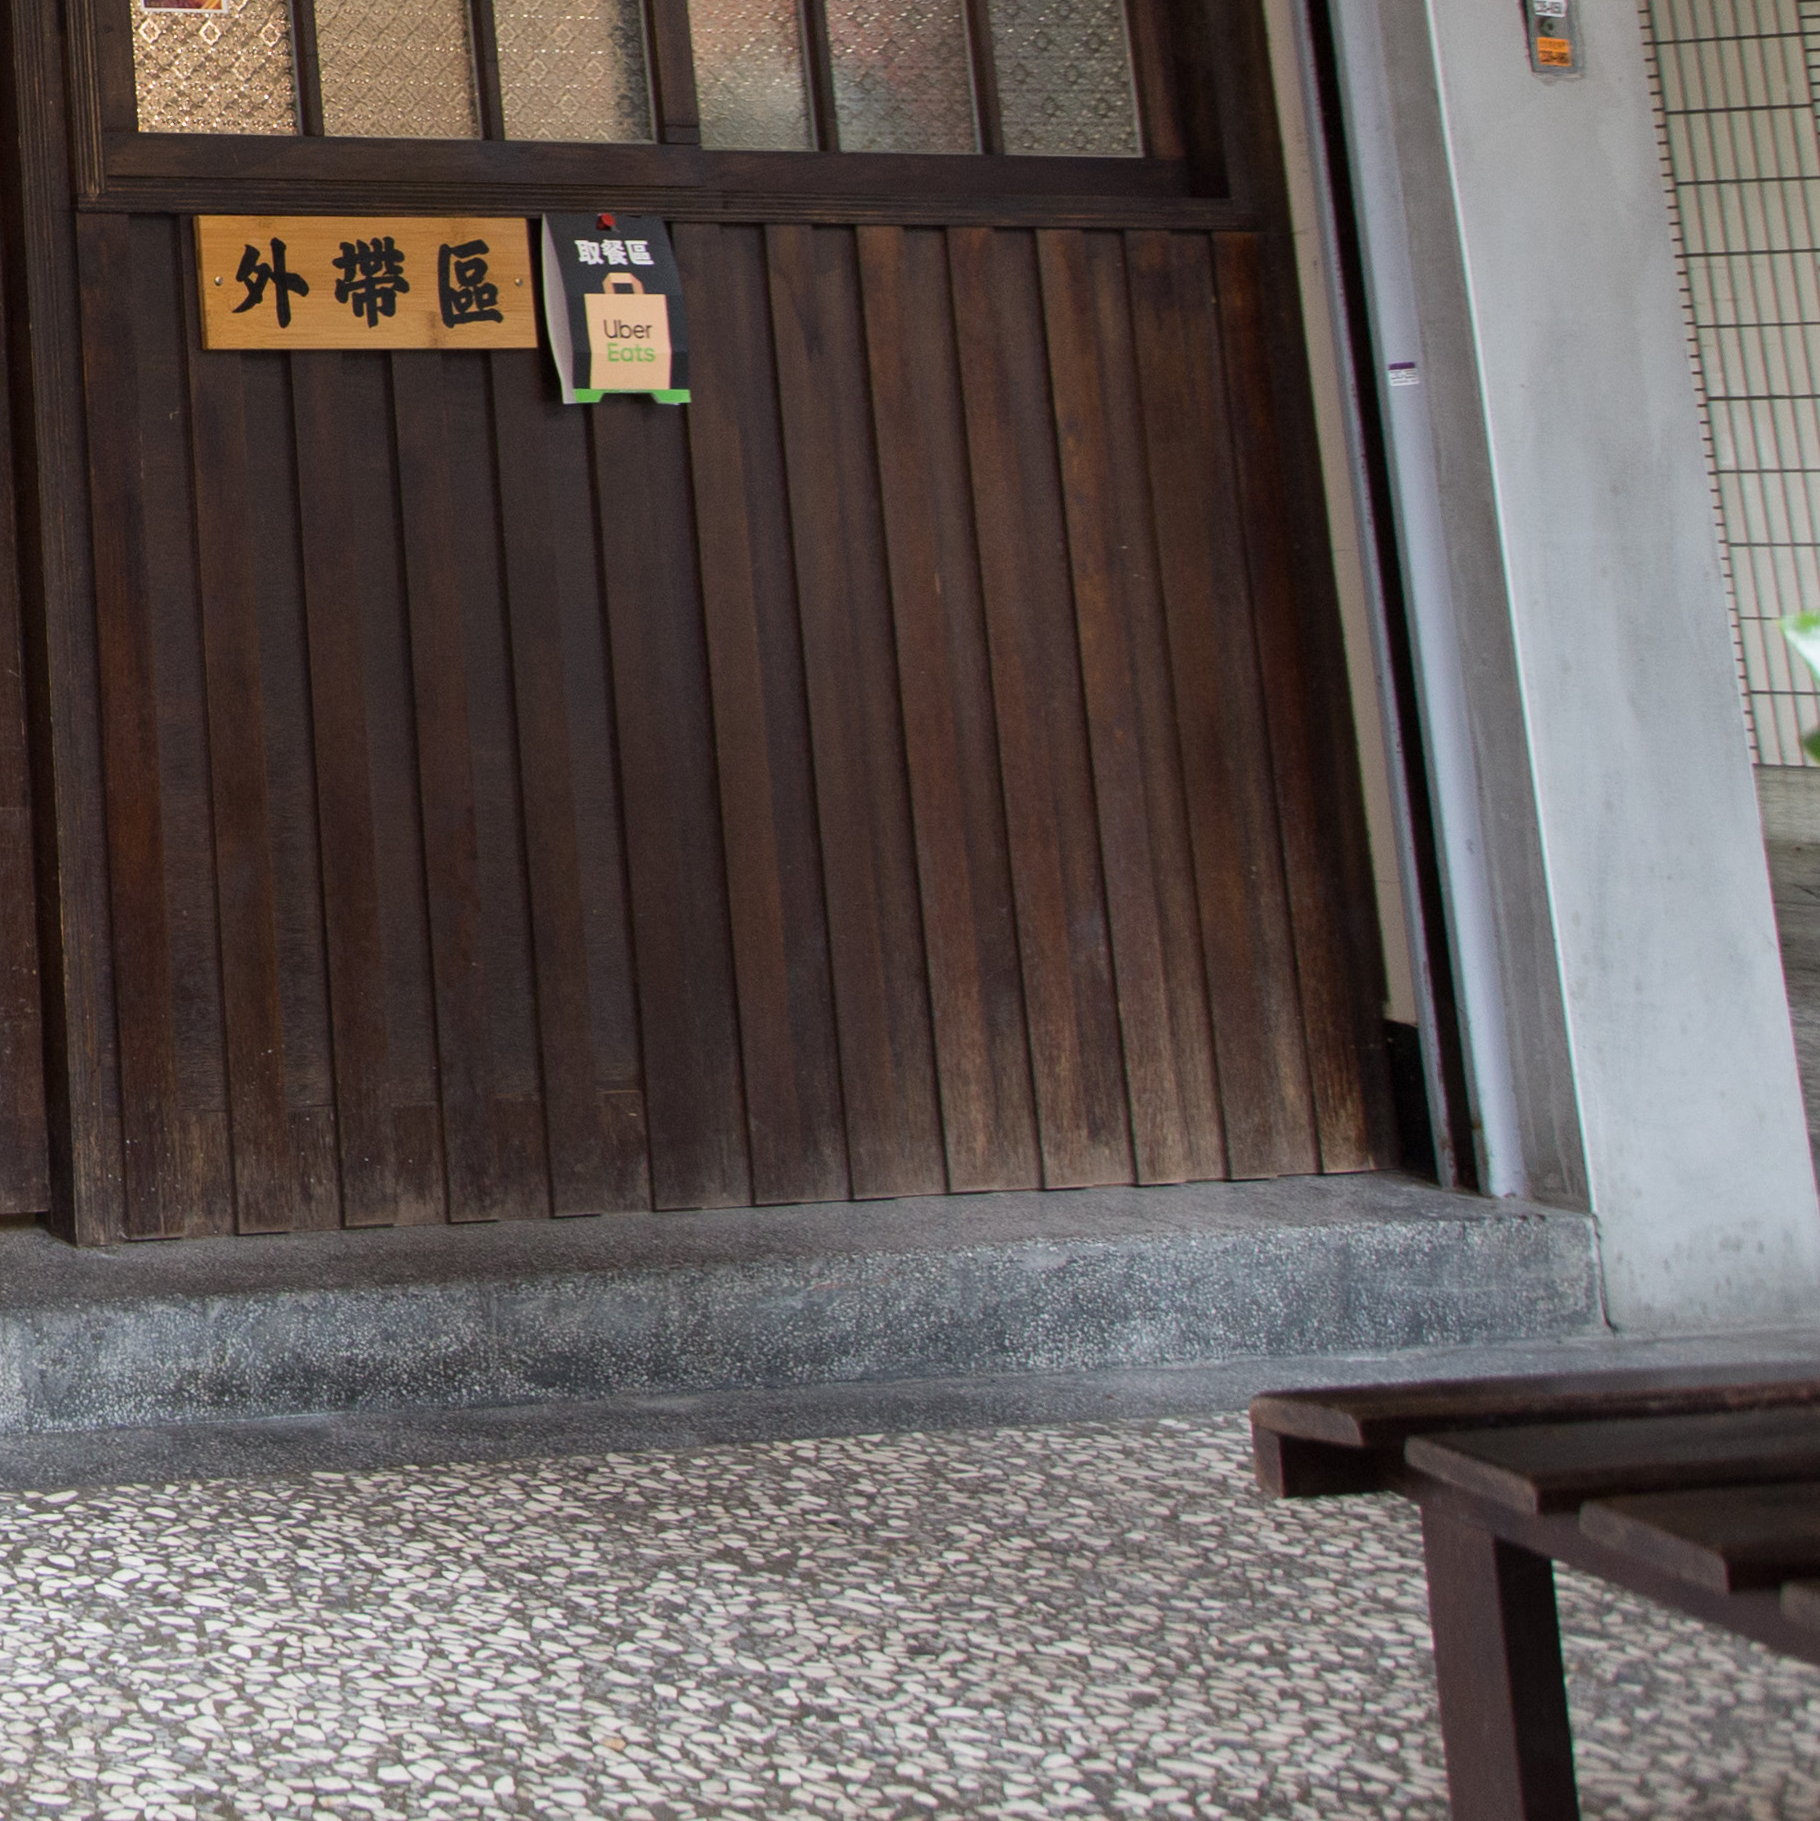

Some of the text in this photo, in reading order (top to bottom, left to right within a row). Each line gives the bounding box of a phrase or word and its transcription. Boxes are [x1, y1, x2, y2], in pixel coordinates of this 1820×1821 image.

[574, 239, 655, 265] 取餐區
[232, 236, 503, 329] 外帶區
[603, 319, 653, 339] Uber
[607, 343, 656, 362] Eats
